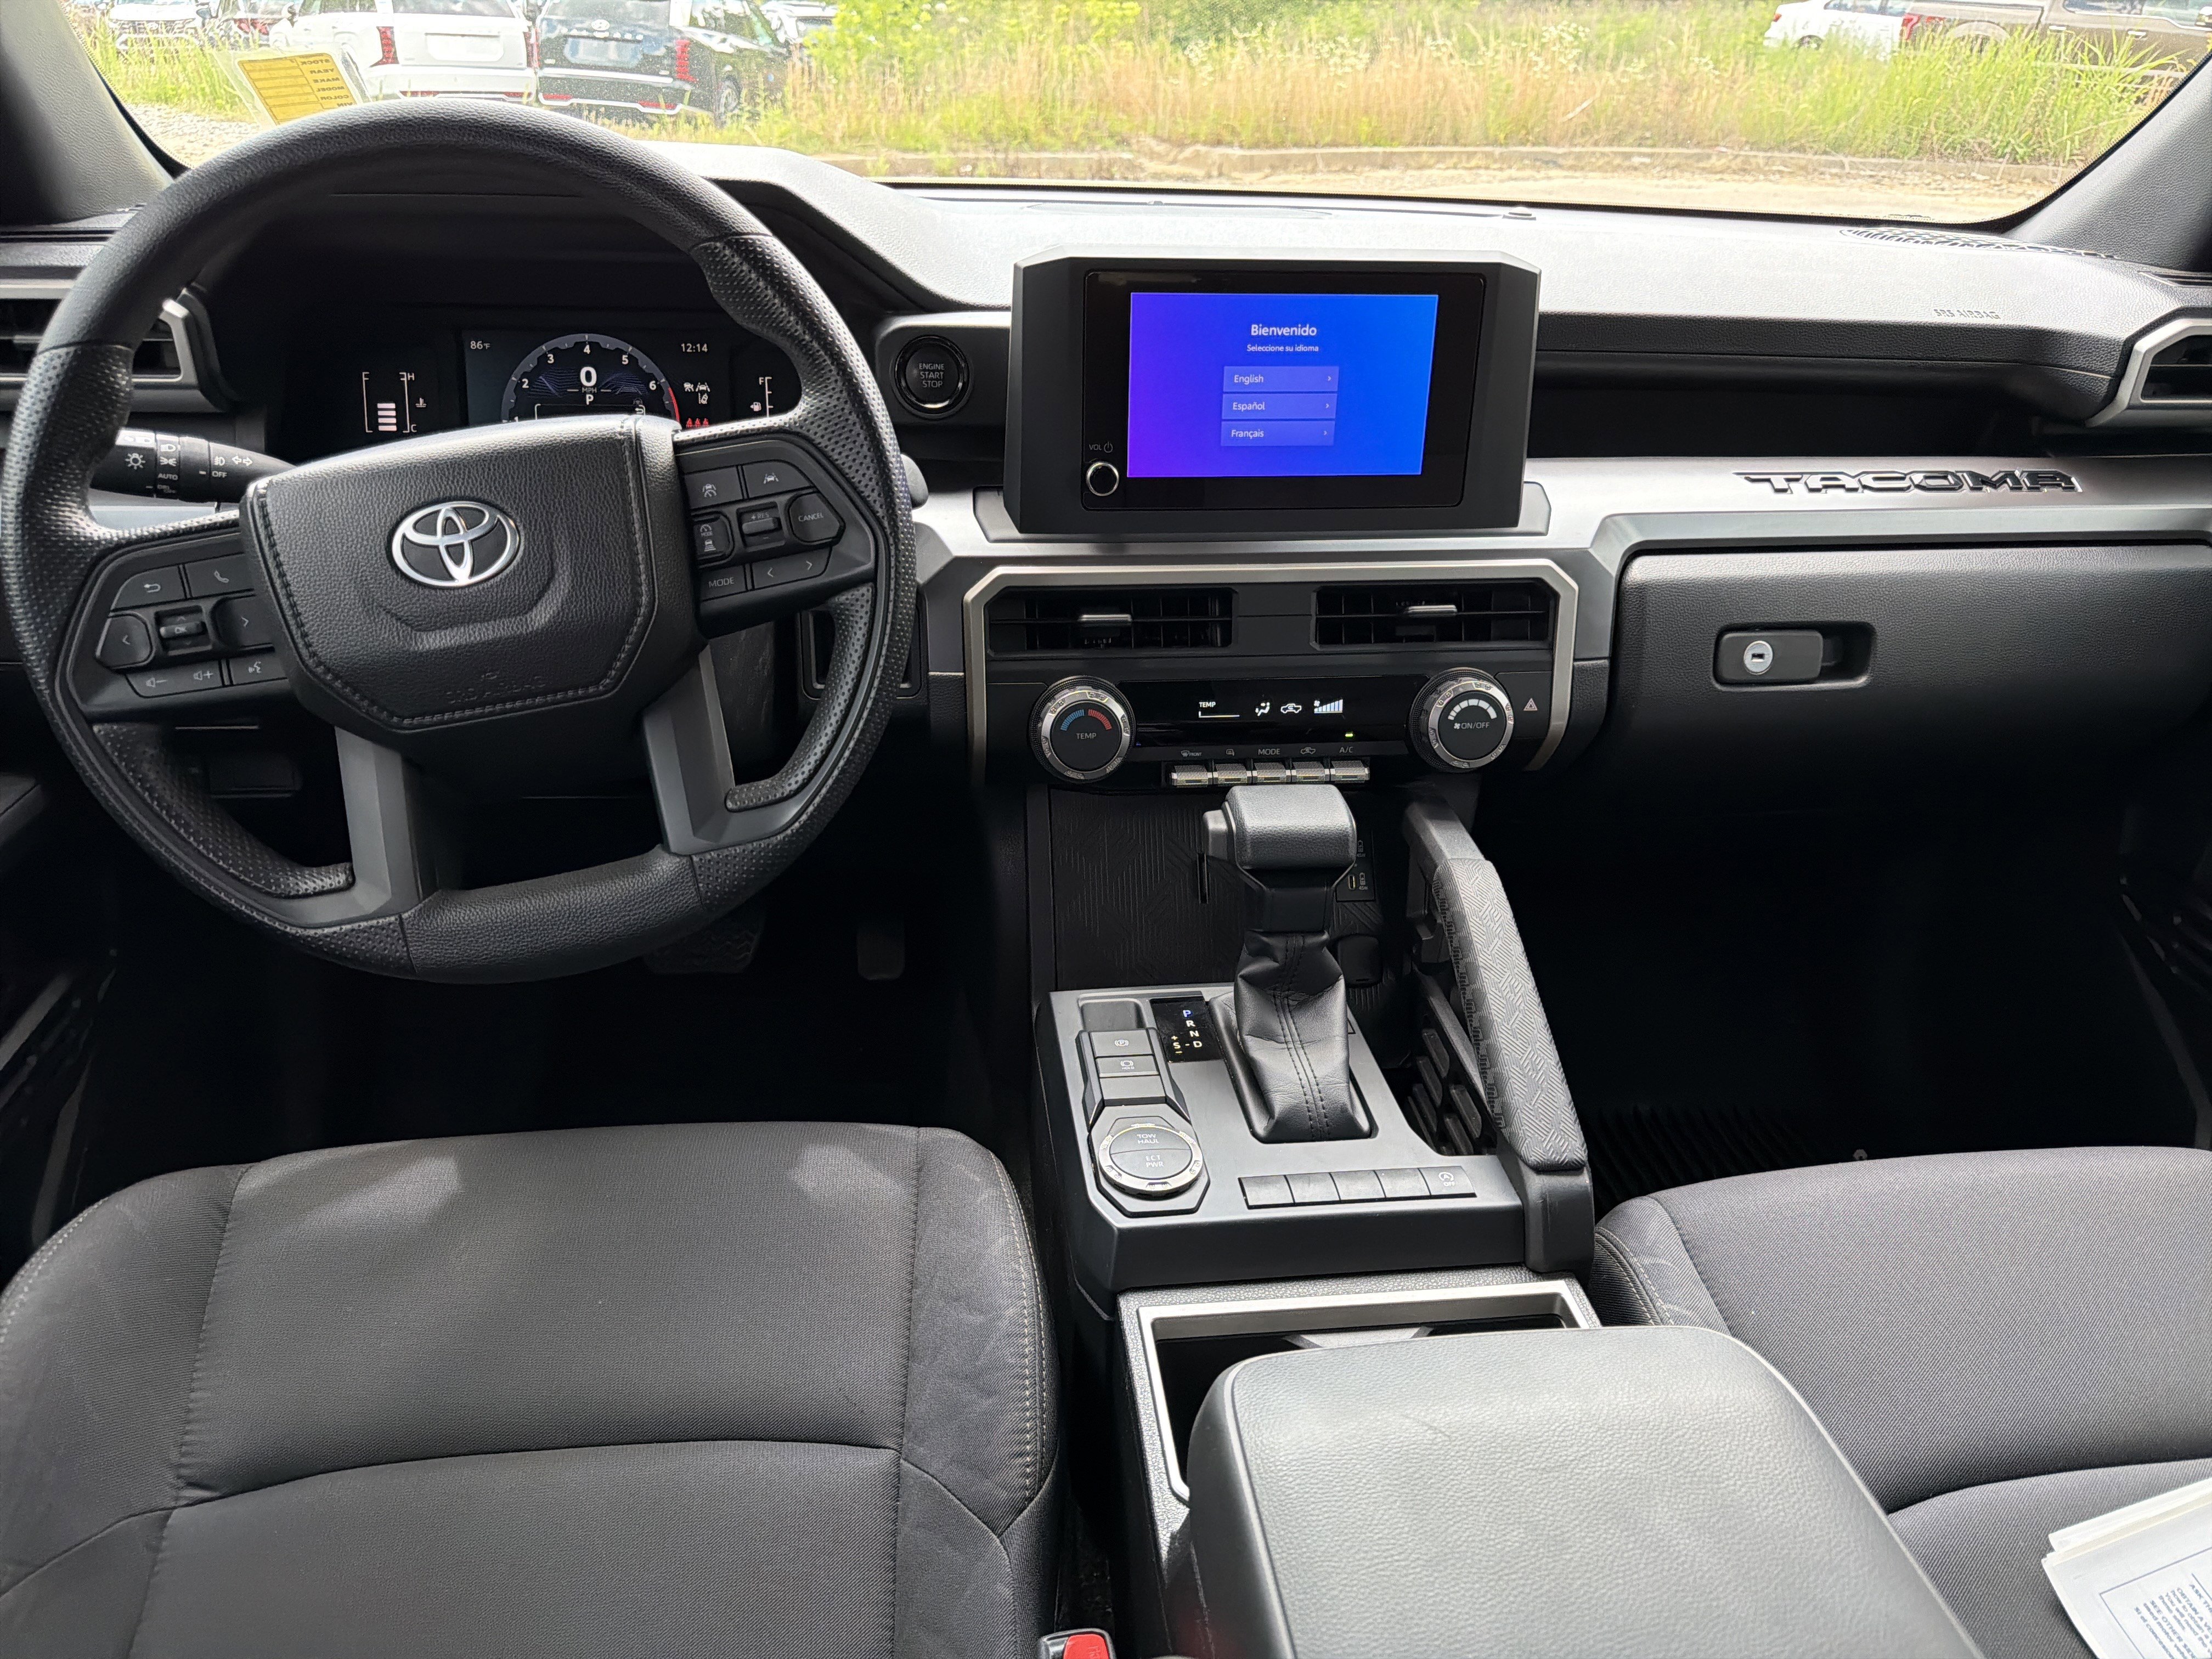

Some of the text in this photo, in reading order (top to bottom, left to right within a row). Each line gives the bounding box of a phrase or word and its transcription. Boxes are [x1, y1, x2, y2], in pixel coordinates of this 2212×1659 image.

[1251, 324, 1317, 336] Bienvenido
[583, 345, 591, 354] 4
[680, 343, 708, 353] 12:14
[1246, 344, 1284, 352] Seleccione
[1295, 344, 1319, 352] idioma
[547, 353, 555, 364] 3
[622, 355, 629, 365] 5
[408, 373, 415, 381] H
[580, 366, 597, 387] 0
[758, 377, 764, 385] F
[1233, 374, 1264, 385] English
[522, 379, 529, 388] 2
[649, 381, 657, 390] 6
[585, 394, 594, 405] P
[1232, 402, 1265, 412] Español
[411, 424, 417, 432] C
[1231, 429, 1265, 440] Français
[1733, 470, 2083, 494] TACOMA
[798, 512, 824, 522] CANCEL
[708, 577, 735, 589] MODE
[1183, 1009, 1192, 1018] P
[2165, 1592, 2175, 1606] You
[2177, 1587, 2199, 1615] OBTAIN
[2150, 1600, 2163, 1615] SEE
[2162, 1616, 2183, 1643] OTHER
